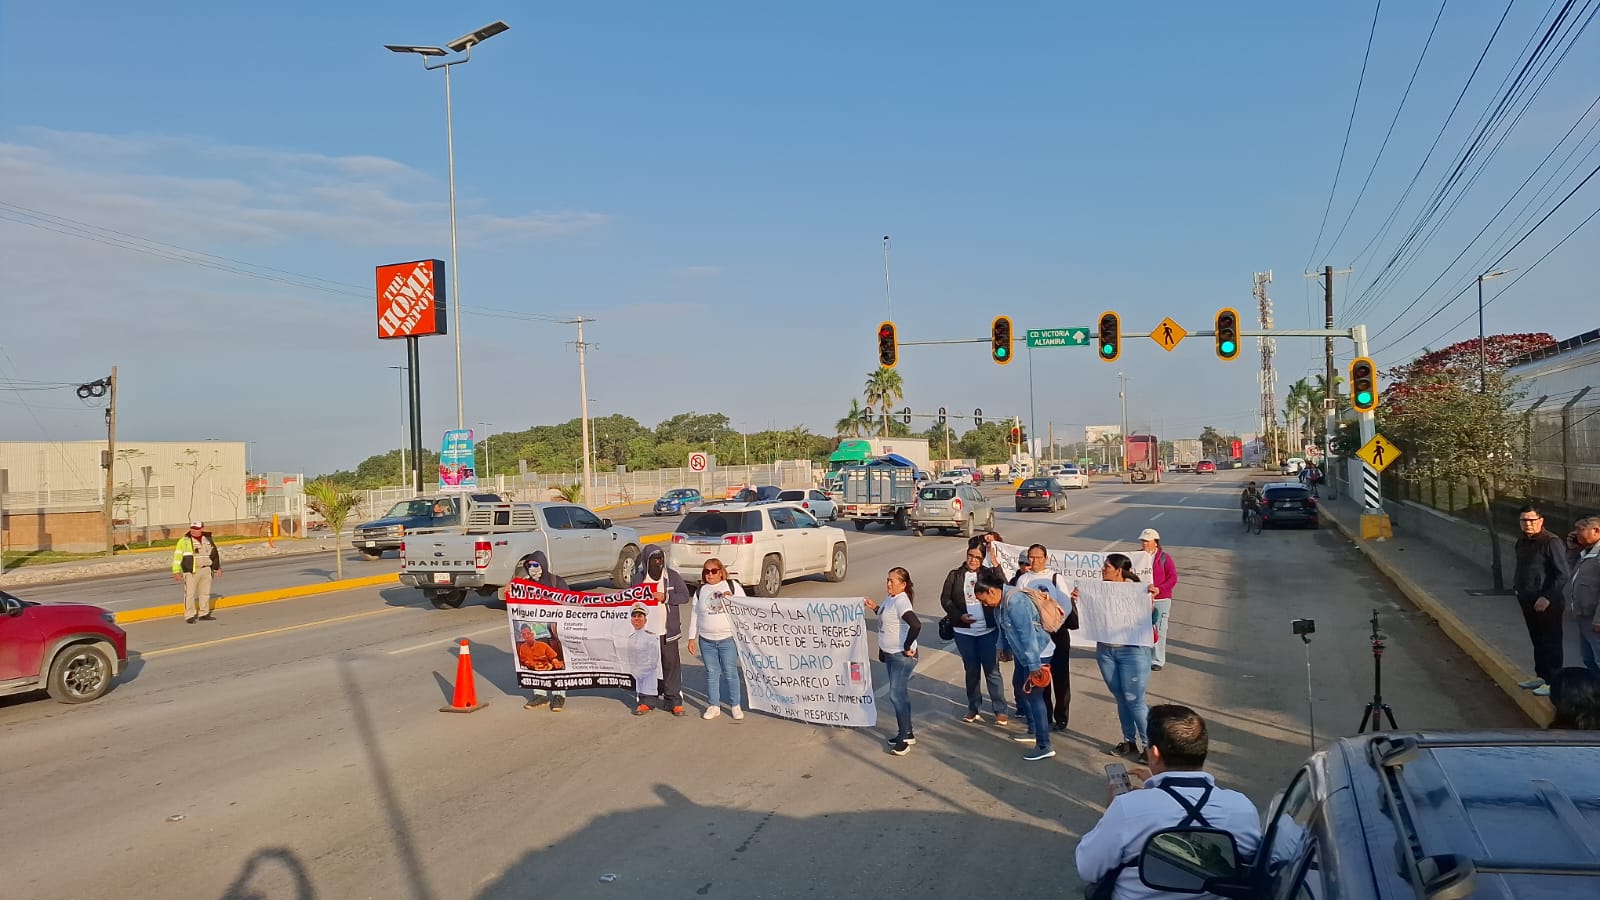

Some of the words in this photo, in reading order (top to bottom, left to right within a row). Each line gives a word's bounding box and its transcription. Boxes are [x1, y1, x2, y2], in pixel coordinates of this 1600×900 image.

[383, 272, 406, 301] THE
[379, 262, 433, 336] HOME
[401, 287, 434, 335] DEPOT
[1034, 338, 1066, 346] ALTAMIRA
[1041, 330, 1070, 338] VICTORIA
[510, 583, 526, 598] MI
[527, 586, 578, 604] FAMILIA
[581, 594, 601, 605] ME
[604, 586, 653, 603] BUSCA
[511, 607, 537, 618] Miguel
[539, 608, 563, 619] Darío
[566, 609, 598, 619] Becerra
[600, 608, 629, 619] Chávez
[722, 597, 767, 618] PEDIMOS
[771, 602, 784, 619] A
[789, 609, 806, 621] LA
[806, 602, 865, 623] MARINA
[753, 622, 778, 632] APOYE
[821, 624, 862, 638] REGRESO
[752, 635, 791, 647] CADETE
[795, 636, 807, 648] DE
[830, 638, 851, 649] AÑO
[789, 653, 833, 670] DARIO
[835, 675, 846, 687] EL
[801, 693, 825, 703] HASTA
[827, 692, 837, 702] EL
[838, 694, 873, 705] MOMENTO
[771, 703, 781, 714] NO
[785, 707, 800, 718] HAY
[804, 708, 850, 721] RESPUESTA
